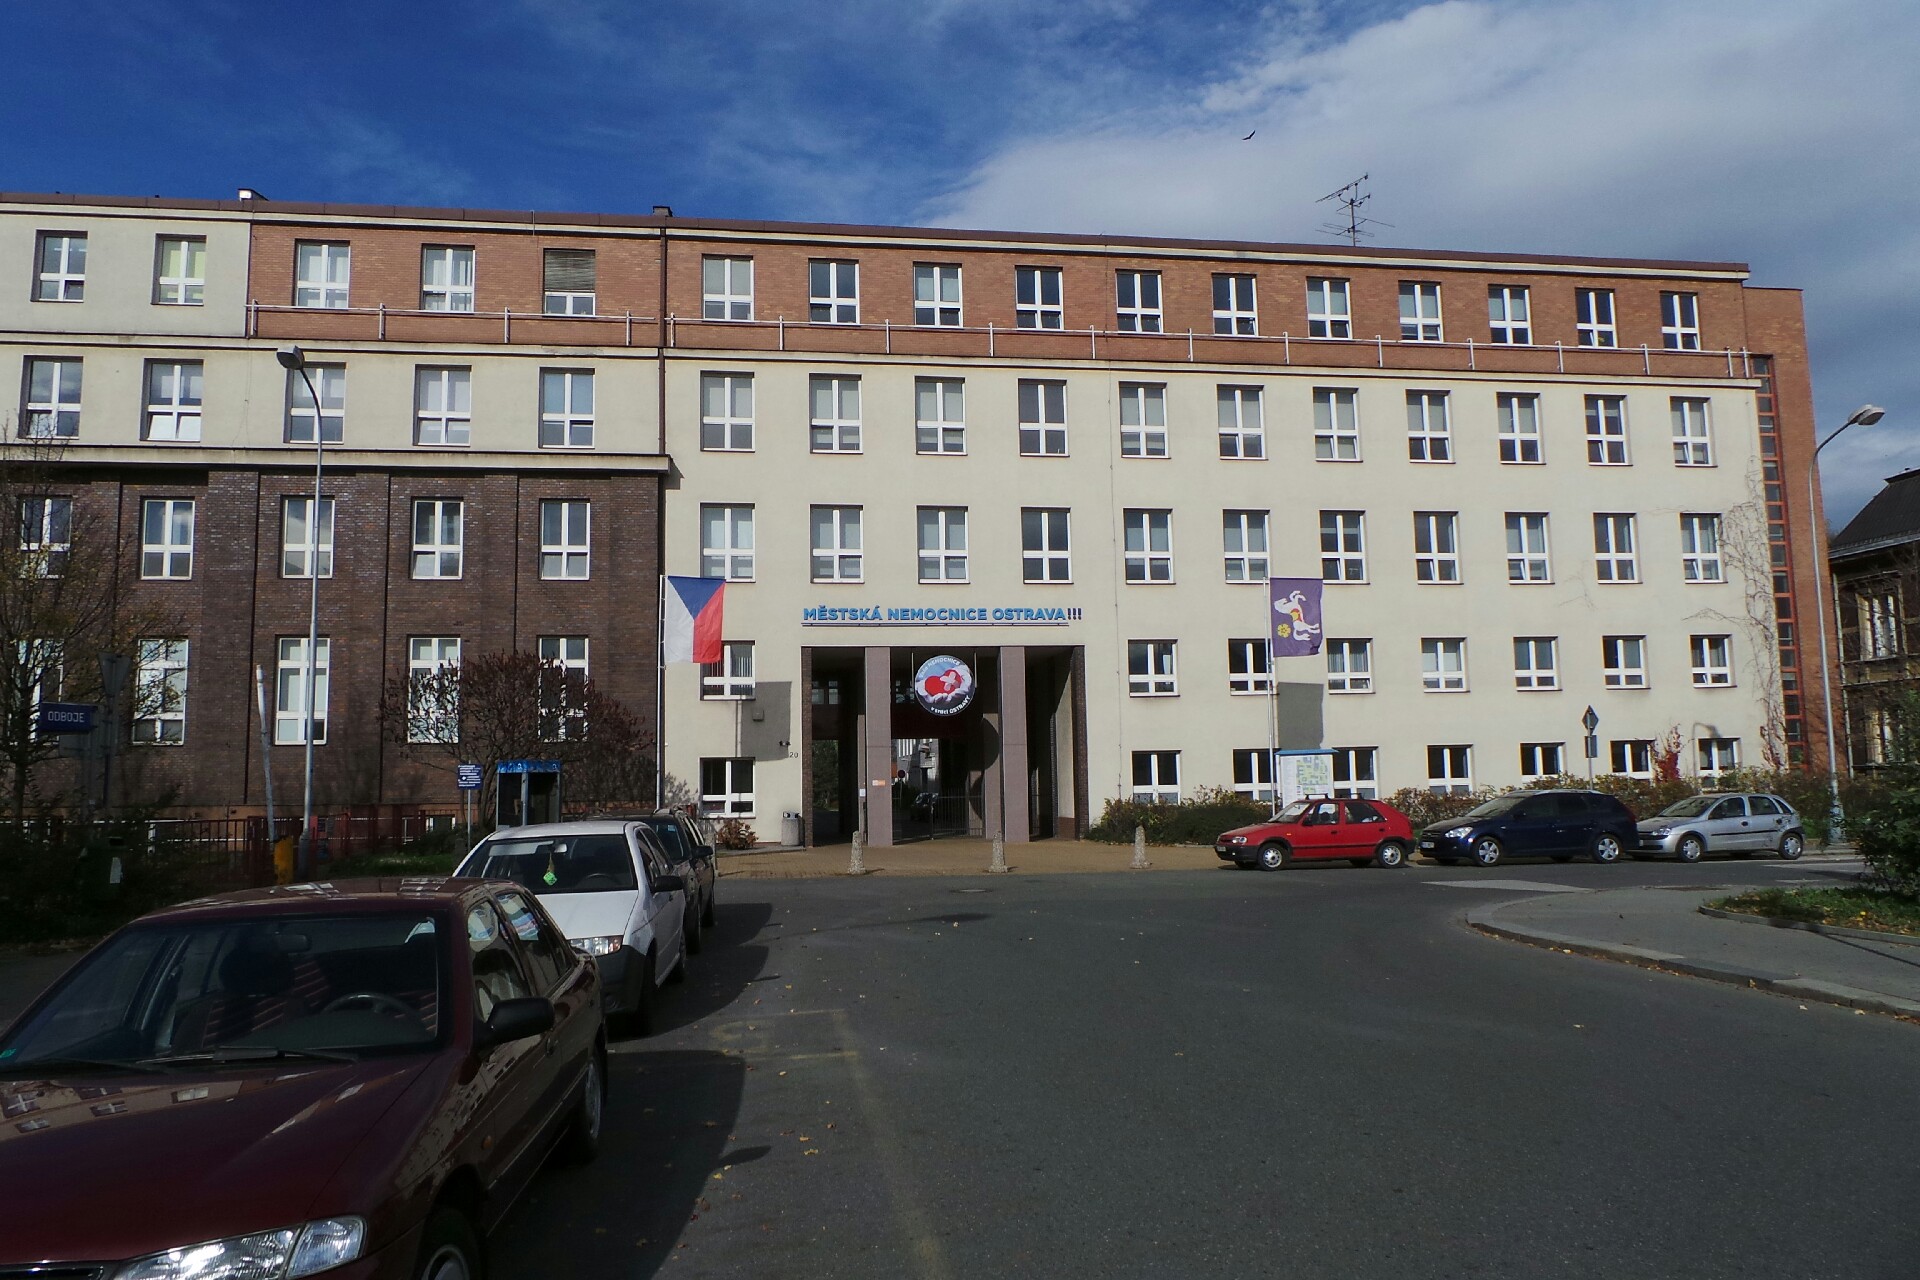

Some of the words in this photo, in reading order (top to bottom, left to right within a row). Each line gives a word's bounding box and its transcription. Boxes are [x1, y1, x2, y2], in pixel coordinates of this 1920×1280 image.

[803, 605, 883, 621] MĚSTSKÁ
[887, 607, 987, 621] NEMOCNICE
[47, 711, 85, 722] ODBOJE
[789, 751, 799, 759] 20
